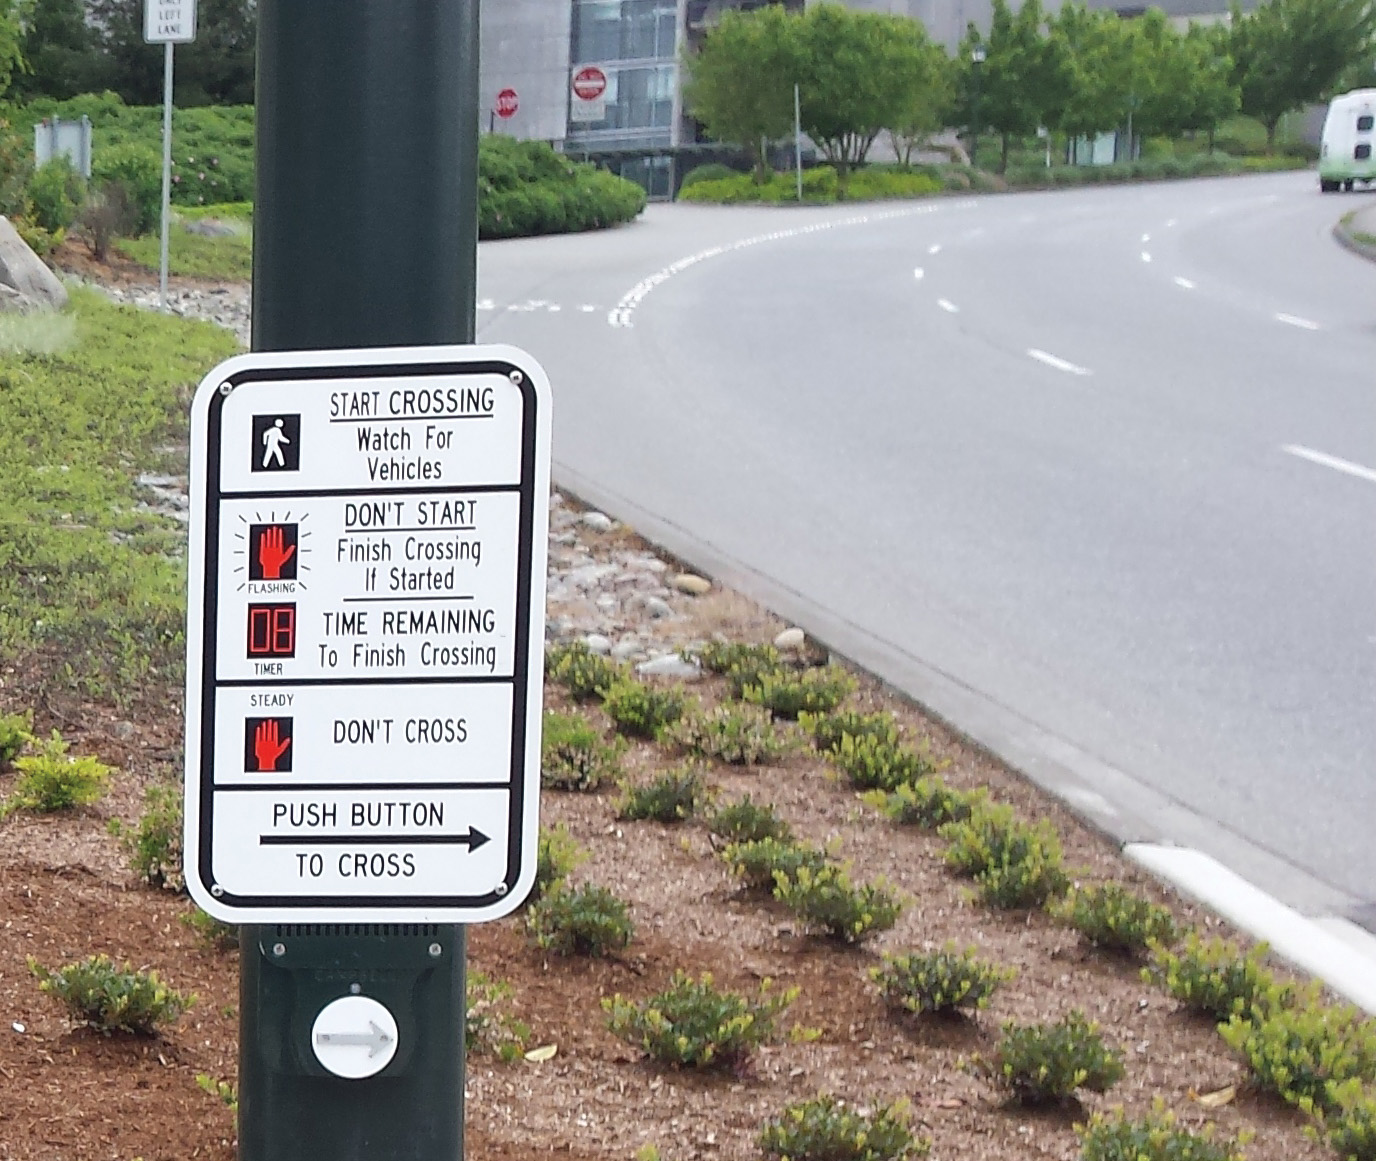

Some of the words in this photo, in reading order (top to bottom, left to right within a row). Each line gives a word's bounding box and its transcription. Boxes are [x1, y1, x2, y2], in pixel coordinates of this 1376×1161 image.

[330, 392, 380, 417] START
[389, 387, 495, 413] CROSSING
[357, 426, 411, 451] Watch
[425, 425, 454, 450] For
[367, 456, 442, 481] Vehicles
[345, 501, 405, 527] DON'T
[417, 500, 478, 525] START
[337, 537, 392, 562] Finish
[404, 536, 481, 566] Crossing
[248, 583, 296, 594] FLASHING
[365, 567, 377, 591] If
[389, 566, 455, 591] Started
[251, 608, 294, 653] 08
[323, 611, 368, 636] TIME
[382, 609, 495, 636] REMAINING
[255, 663, 283, 676] TIMER
[318, 644, 338, 668] To
[353, 643, 406, 668] Finish
[420, 640, 496, 673] Crossing
[250, 693, 294, 706] STEADY
[333, 719, 394, 745] DON'T
[405, 718, 468, 743] CROSS
[273, 802, 337, 828] PUSH
[351, 801, 444, 827] BUTTON
[295, 853, 324, 878] TO
[338, 852, 416, 878] CROSS
